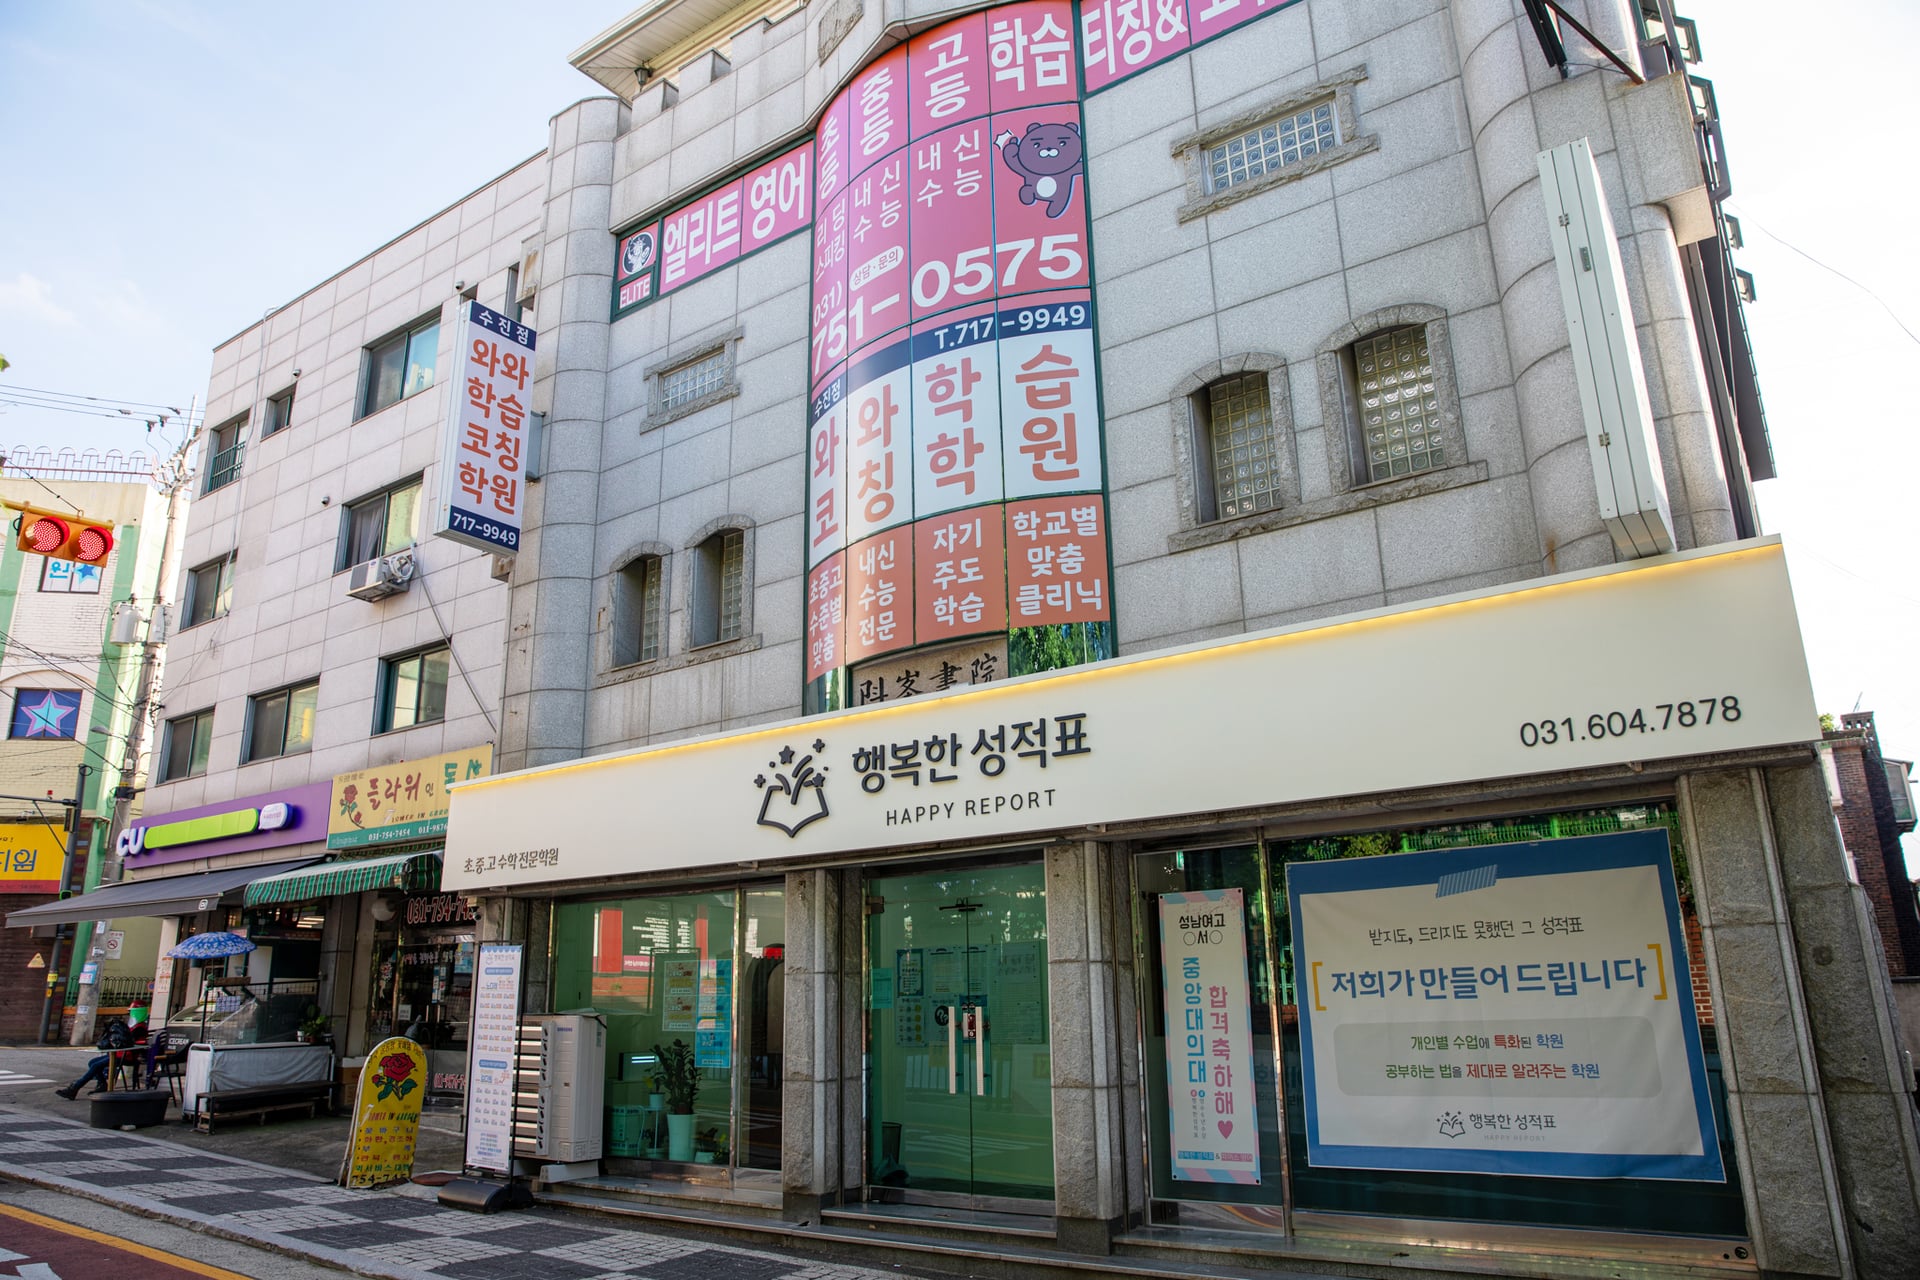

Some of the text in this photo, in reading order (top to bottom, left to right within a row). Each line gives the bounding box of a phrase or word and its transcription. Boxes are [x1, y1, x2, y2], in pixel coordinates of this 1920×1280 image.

[989, 13, 1071, 92] 학습
[925, 33, 970, 118] 고등
[860, 68, 895, 157] 중등
[819, 115, 840, 200] 초등
[918, 128, 981, 171] 내신
[855, 160, 900, 209] 내신
[917, 167, 983, 208] 수능
[664, 152, 806, 284] 엘리트 영어
[817, 198, 846, 248] 리딩
[853, 199, 902, 243] 수능
[815, 230, 845, 284] 스피킹
[619, 280, 651, 309] ELITE
[812, 233, 1082, 376] 751-0575
[813, 281, 843, 327] 031)
[479, 310, 529, 345] 수진점
[934, 304, 1086, 350] T.717-9949
[470, 338, 530, 391] 와와
[467, 376, 525, 430] 학습
[813, 379, 841, 418] 수진점
[461, 422, 520, 472] 코칭
[459, 461, 517, 515] 학원
[453, 513, 517, 546] 717-9949
[934, 518, 982, 554] 자기
[1012, 505, 1099, 542] 학교별
[859, 540, 895, 576] 내신
[933, 557, 984, 591] 주도
[1027, 543, 1085, 578] 맞춤
[810, 565, 843, 604] 초중고
[858, 579, 897, 612] 수능
[1016, 579, 1102, 616] 클리닉
[810, 594, 842, 637] 수준별
[933, 592, 985, 626] 학습
[858, 611, 897, 647] 전문
[813, 631, 836, 669] 맞춤
[1519, 695, 1742, 748] 031.604.7878
[852, 713, 1092, 794] 행복한 성적표
[367, 772, 422, 811] 플라워
[886, 789, 1057, 827] HAPPY REPORT
[116, 826, 146, 857] CU
[1179, 913, 1226, 929] 성남여고
[1369, 916, 1585, 946] 받지도, 드리지도 못했던 그 성적표
[1209, 985, 1234, 1115] 합격축하해
[1411, 1033, 1564, 1051] 개인별 수업에 특화된 학원
[1385, 1063, 1600, 1079] 공부하는 법을 제대로 알려주는 학원
[1469, 1113, 1557, 1130] 행복한 성적표
